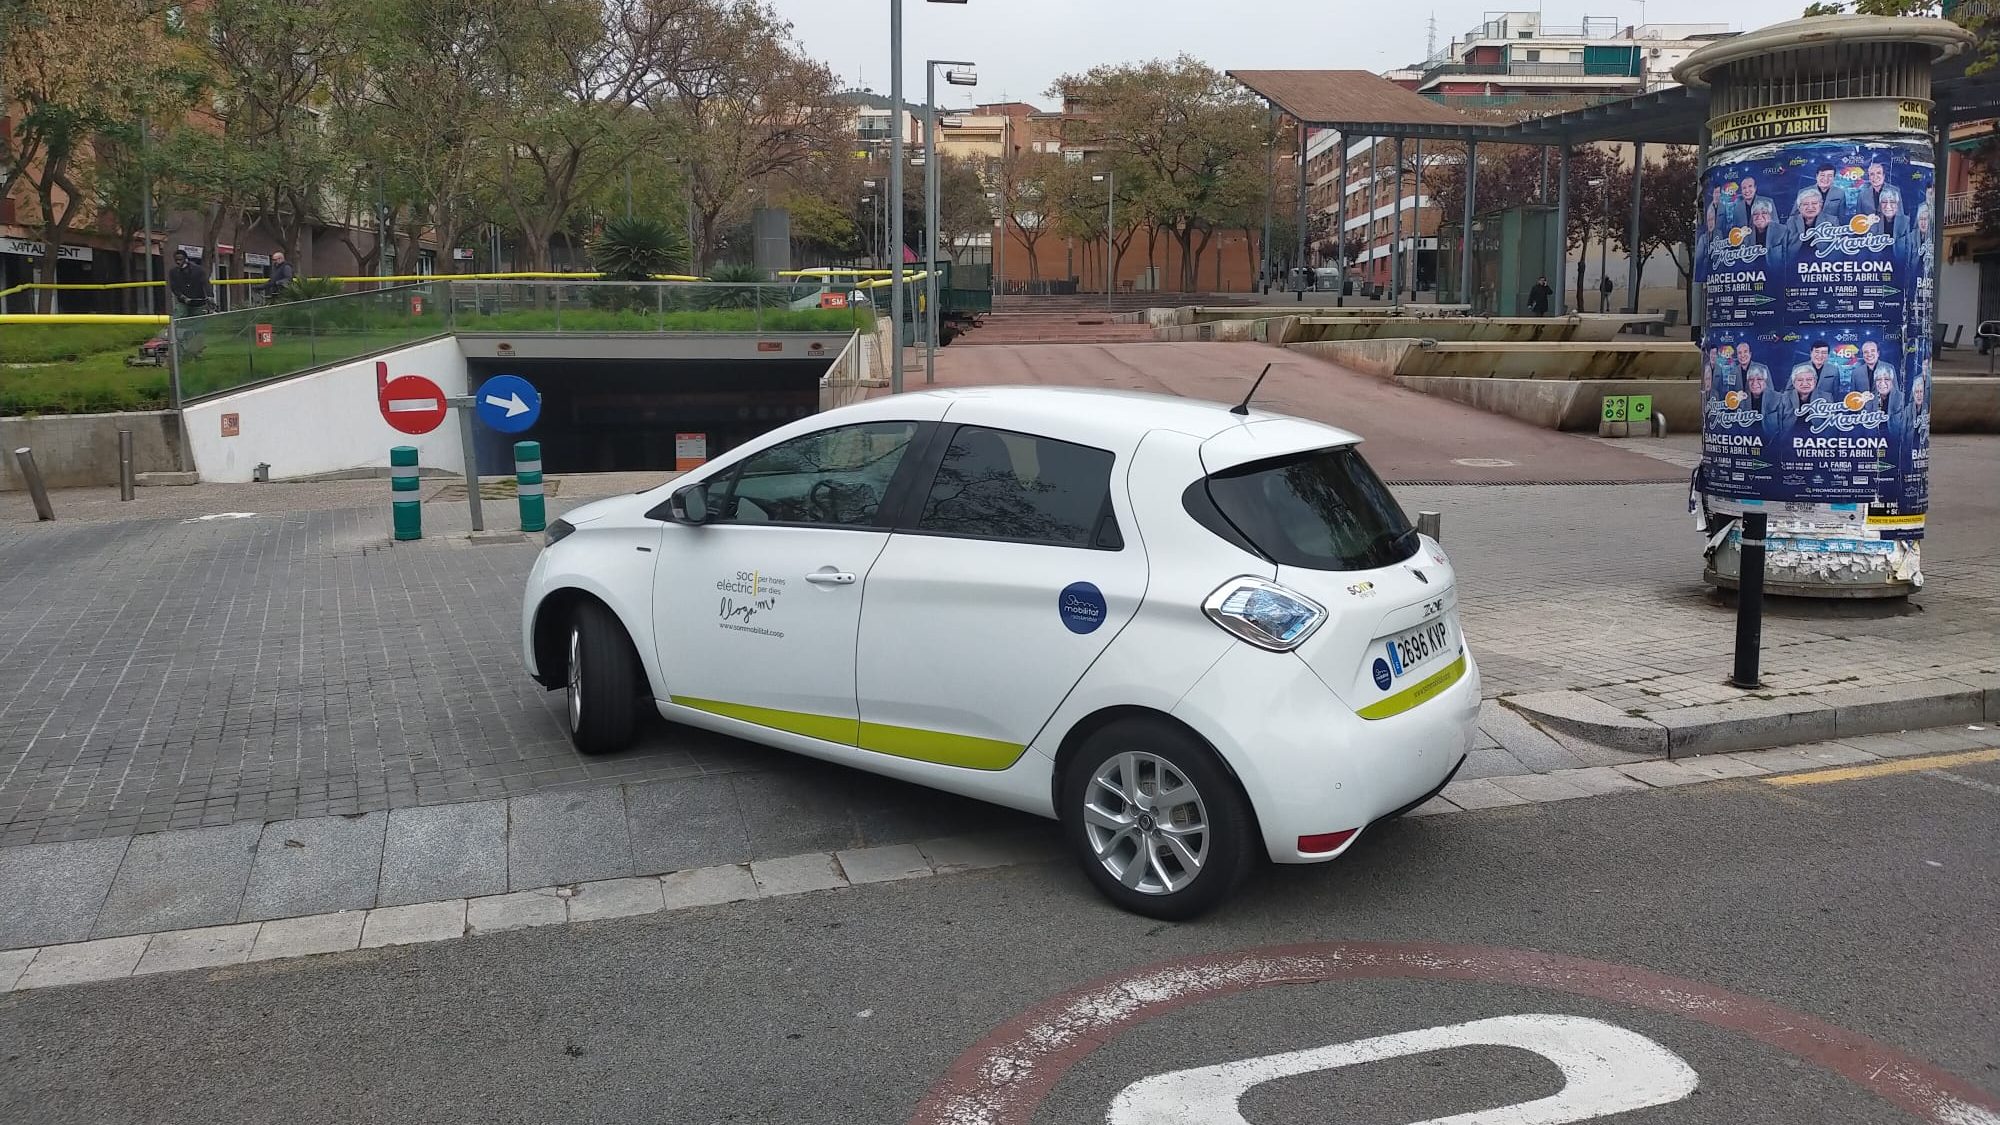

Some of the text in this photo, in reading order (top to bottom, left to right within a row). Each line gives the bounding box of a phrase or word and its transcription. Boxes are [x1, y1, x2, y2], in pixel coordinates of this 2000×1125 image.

[1775, 107, 1801, 119] PORT
[1805, 104, 1828, 116] VELL
[1724, 130, 1739, 144] FINS
[1741, 129, 1747, 141] A
[1798, 261, 1893, 274] BARCELONA
[1707, 271, 1766, 285] BARCELONA
[1801, 273, 1840, 283] VIERNES
[1843, 273, 1853, 282] 15
[1855, 273, 1880, 282] ABRIL
[1725, 284, 1731, 292] 15
[1732, 283, 1752, 292] ABRIL
[1835, 285, 1858, 293] FARGA
[1705, 432, 1763, 447] BARCELONA
[1793, 437, 1888, 449] BARCELONA
[1722, 445, 1729, 454] 15
[1730, 446, 1750, 455] ABRIL
[1796, 449, 1836, 458] VIERNES
[1838, 449, 1848, 458] 15
[1849, 449, 1875, 458] ABRIL
[1819, 461, 1829, 469] LA
[736, 571, 754, 582] soc
[768, 576, 785, 586] hores
[768, 586, 781, 595] dies
[1064, 605, 1099, 617] mobilitat
[1398, 622, 1447, 668] 2696 KVP
